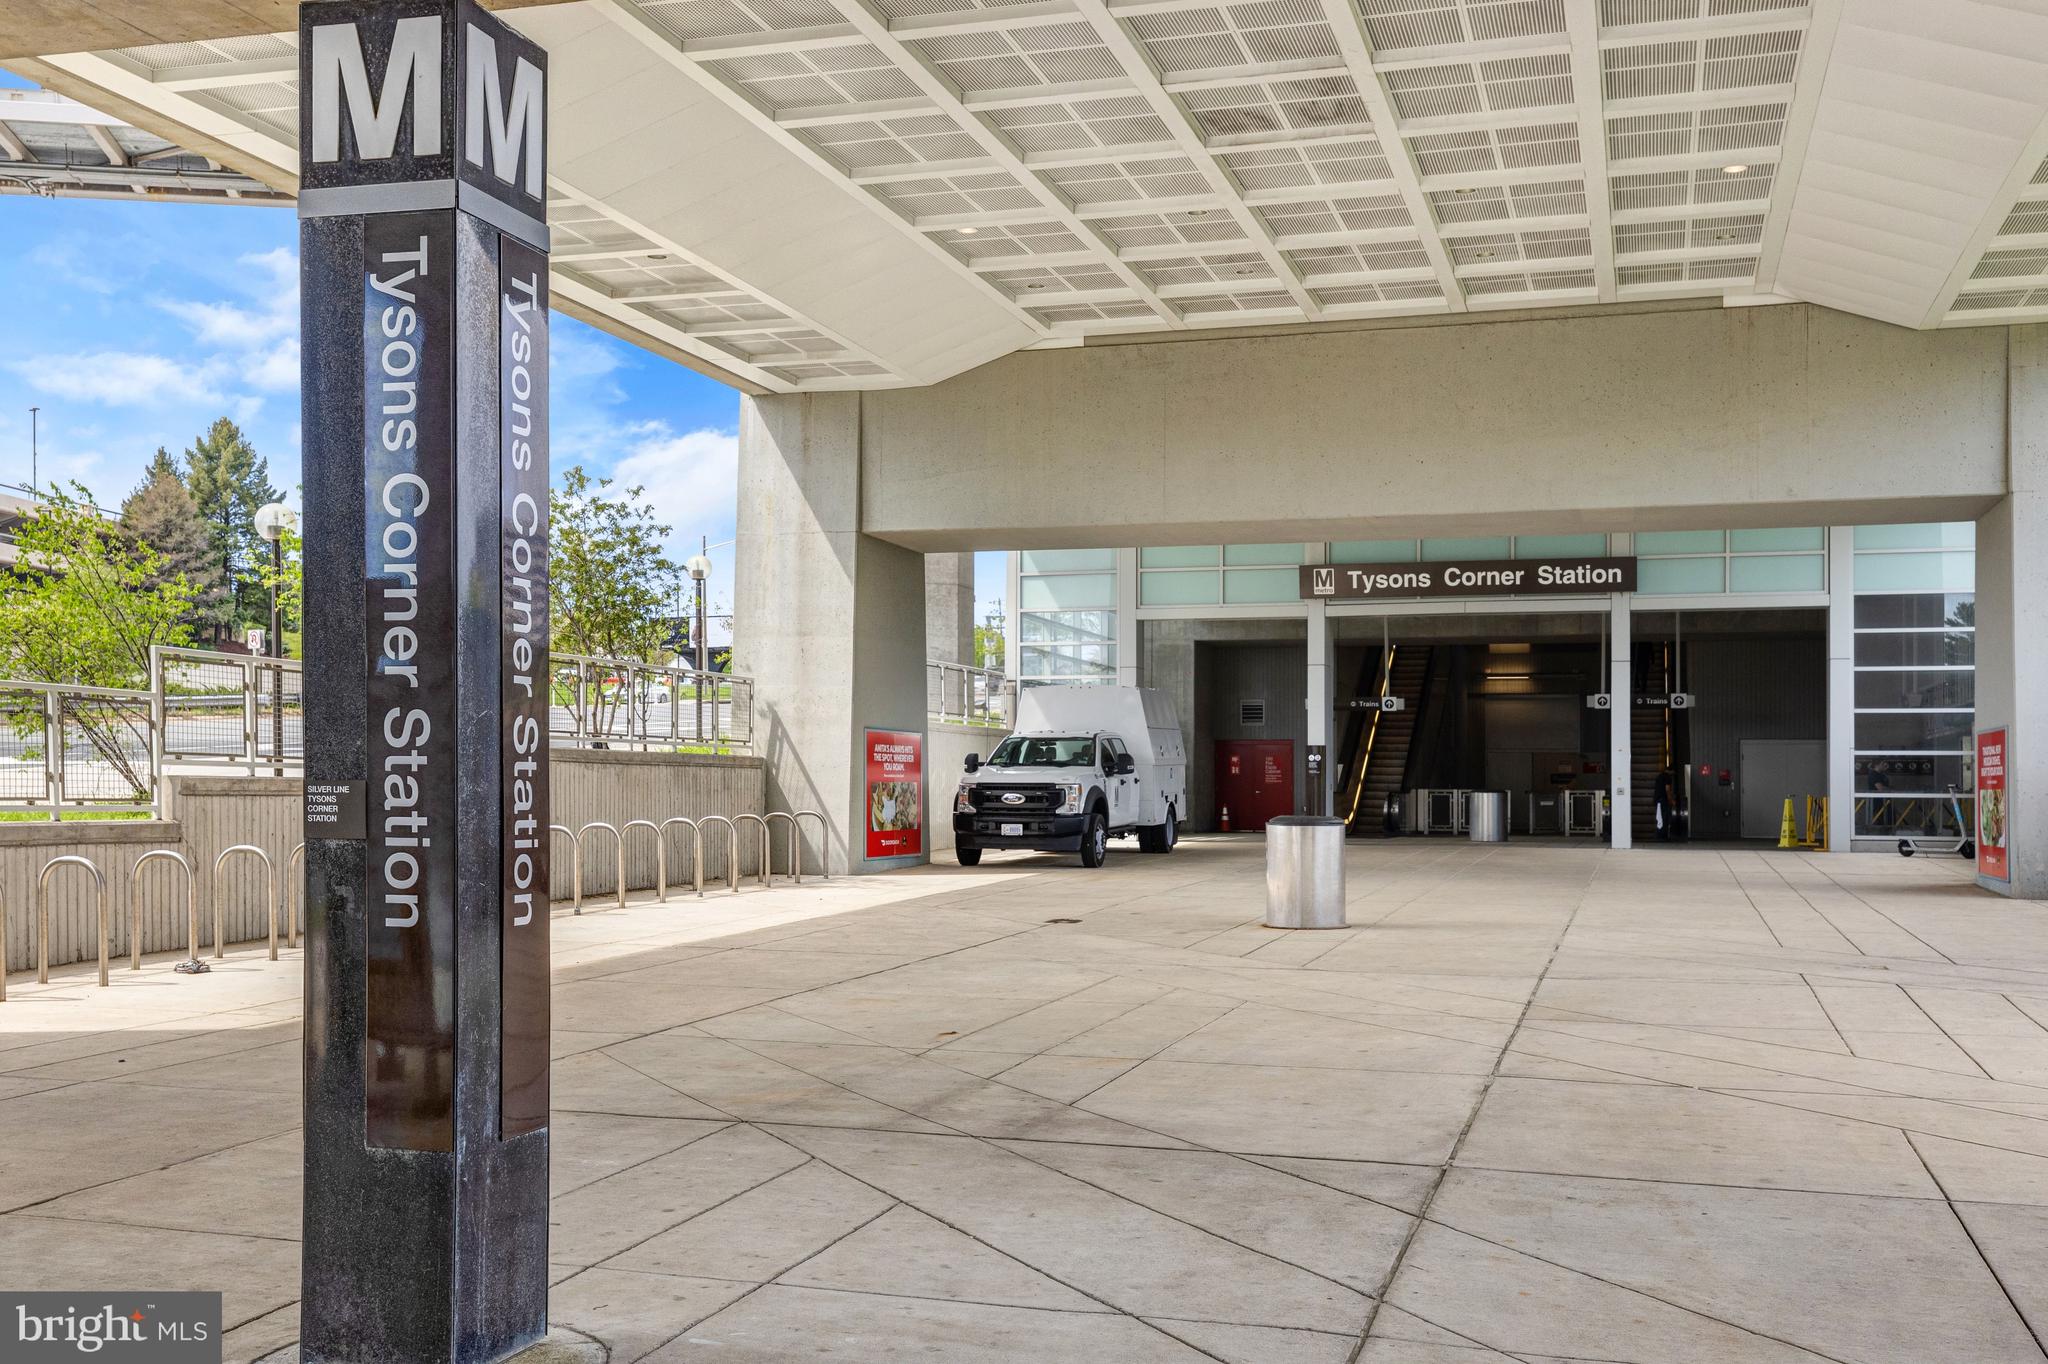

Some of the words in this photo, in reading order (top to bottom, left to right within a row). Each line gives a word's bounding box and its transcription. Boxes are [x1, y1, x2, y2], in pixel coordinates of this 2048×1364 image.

[312, 15, 442, 163] M
[465, 22, 543, 202] M
[370, 235, 428, 452] Tysons
[505, 272, 538, 471] Tysons
[383, 472, 430, 688] Corner
[512, 492, 538, 698] Corner
[1314, 569, 1334, 588] M
[1347, 570, 1432, 594] Tysons
[1444, 567, 1525, 587] Corner
[1537, 564, 1622, 585] Station
[307, 785, 332, 793] SILVER
[333, 785, 350, 793] LINE
[307, 795, 337, 803] TYSONS
[307, 805, 339, 813] CORNER
[383, 707, 431, 928] Station
[513, 716, 539, 927] Station
